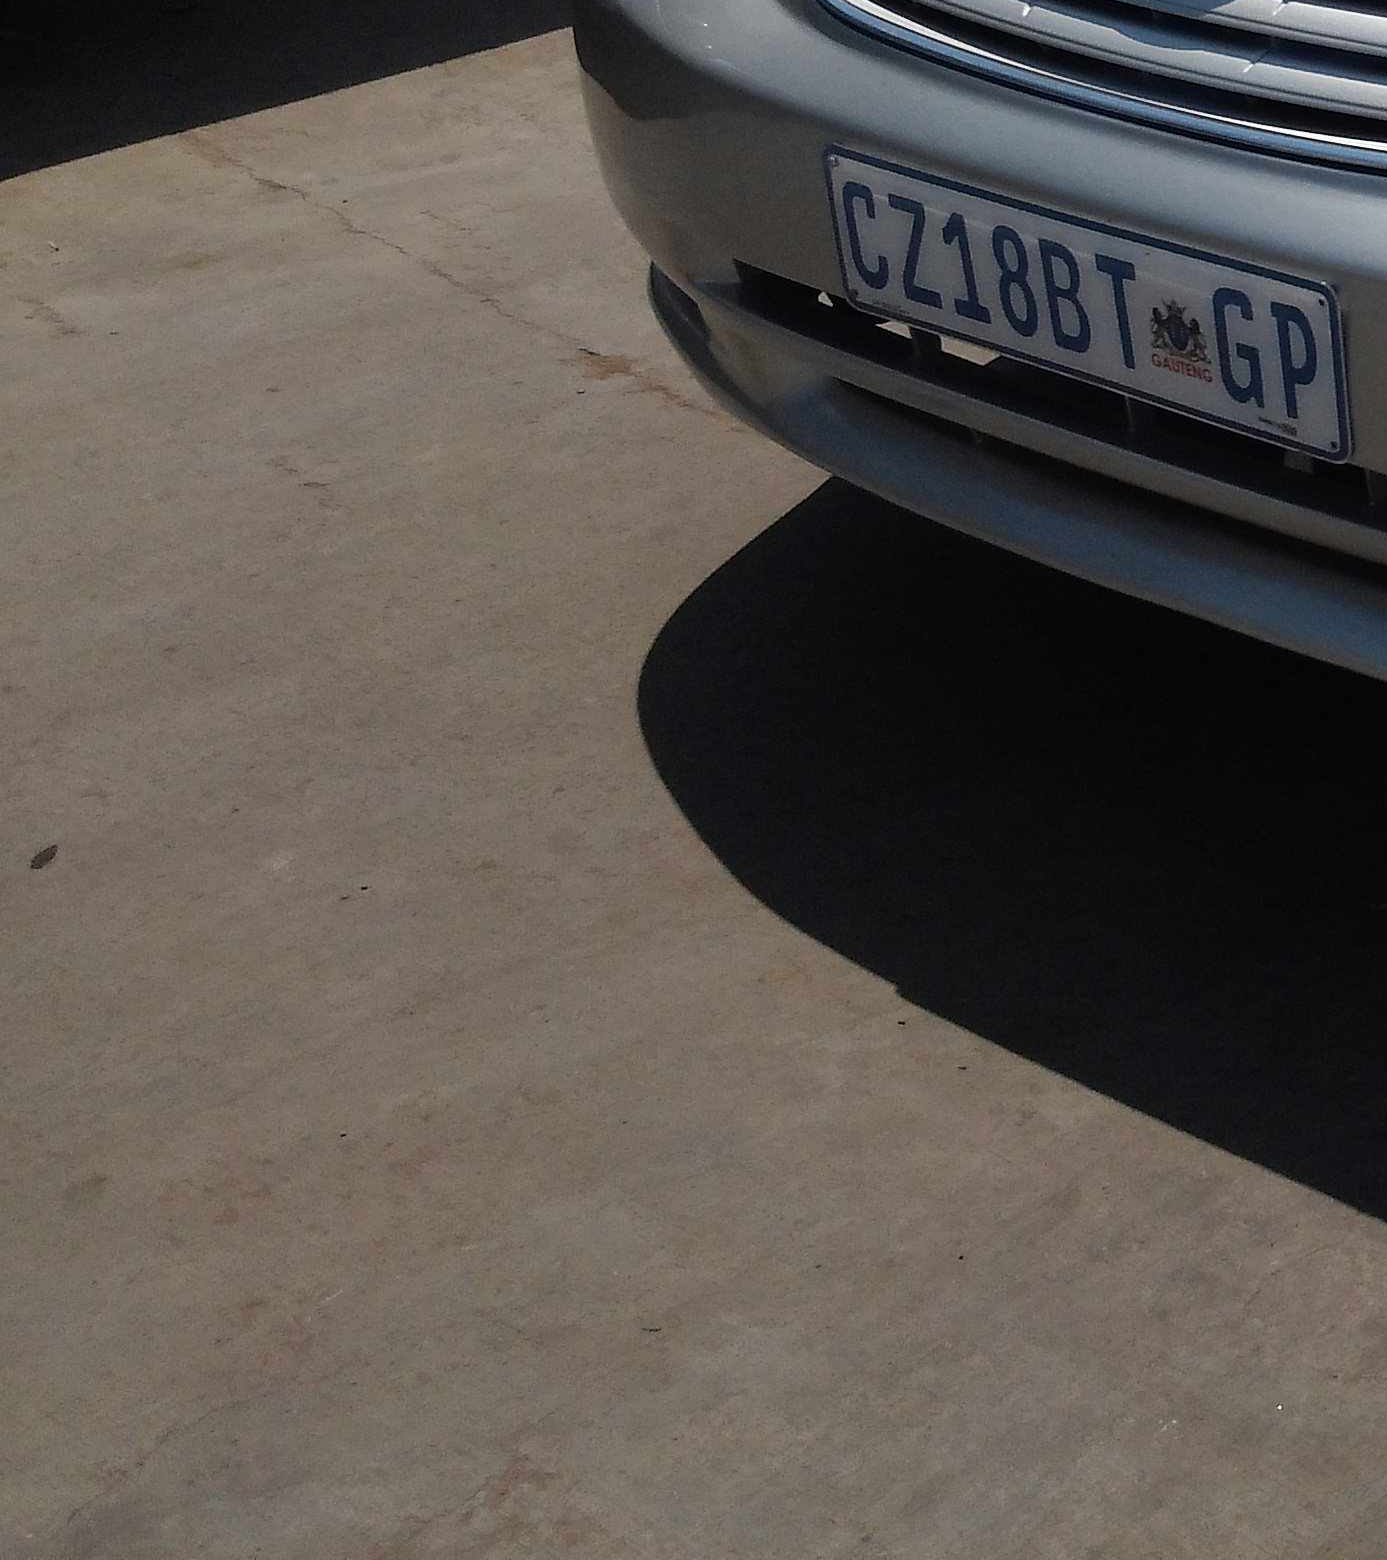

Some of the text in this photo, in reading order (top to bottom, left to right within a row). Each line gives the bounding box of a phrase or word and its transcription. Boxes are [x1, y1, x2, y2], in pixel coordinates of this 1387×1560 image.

[841, 180, 1319, 419] CZ18BT GP
[1151, 353, 1213, 383] GAUTENG
